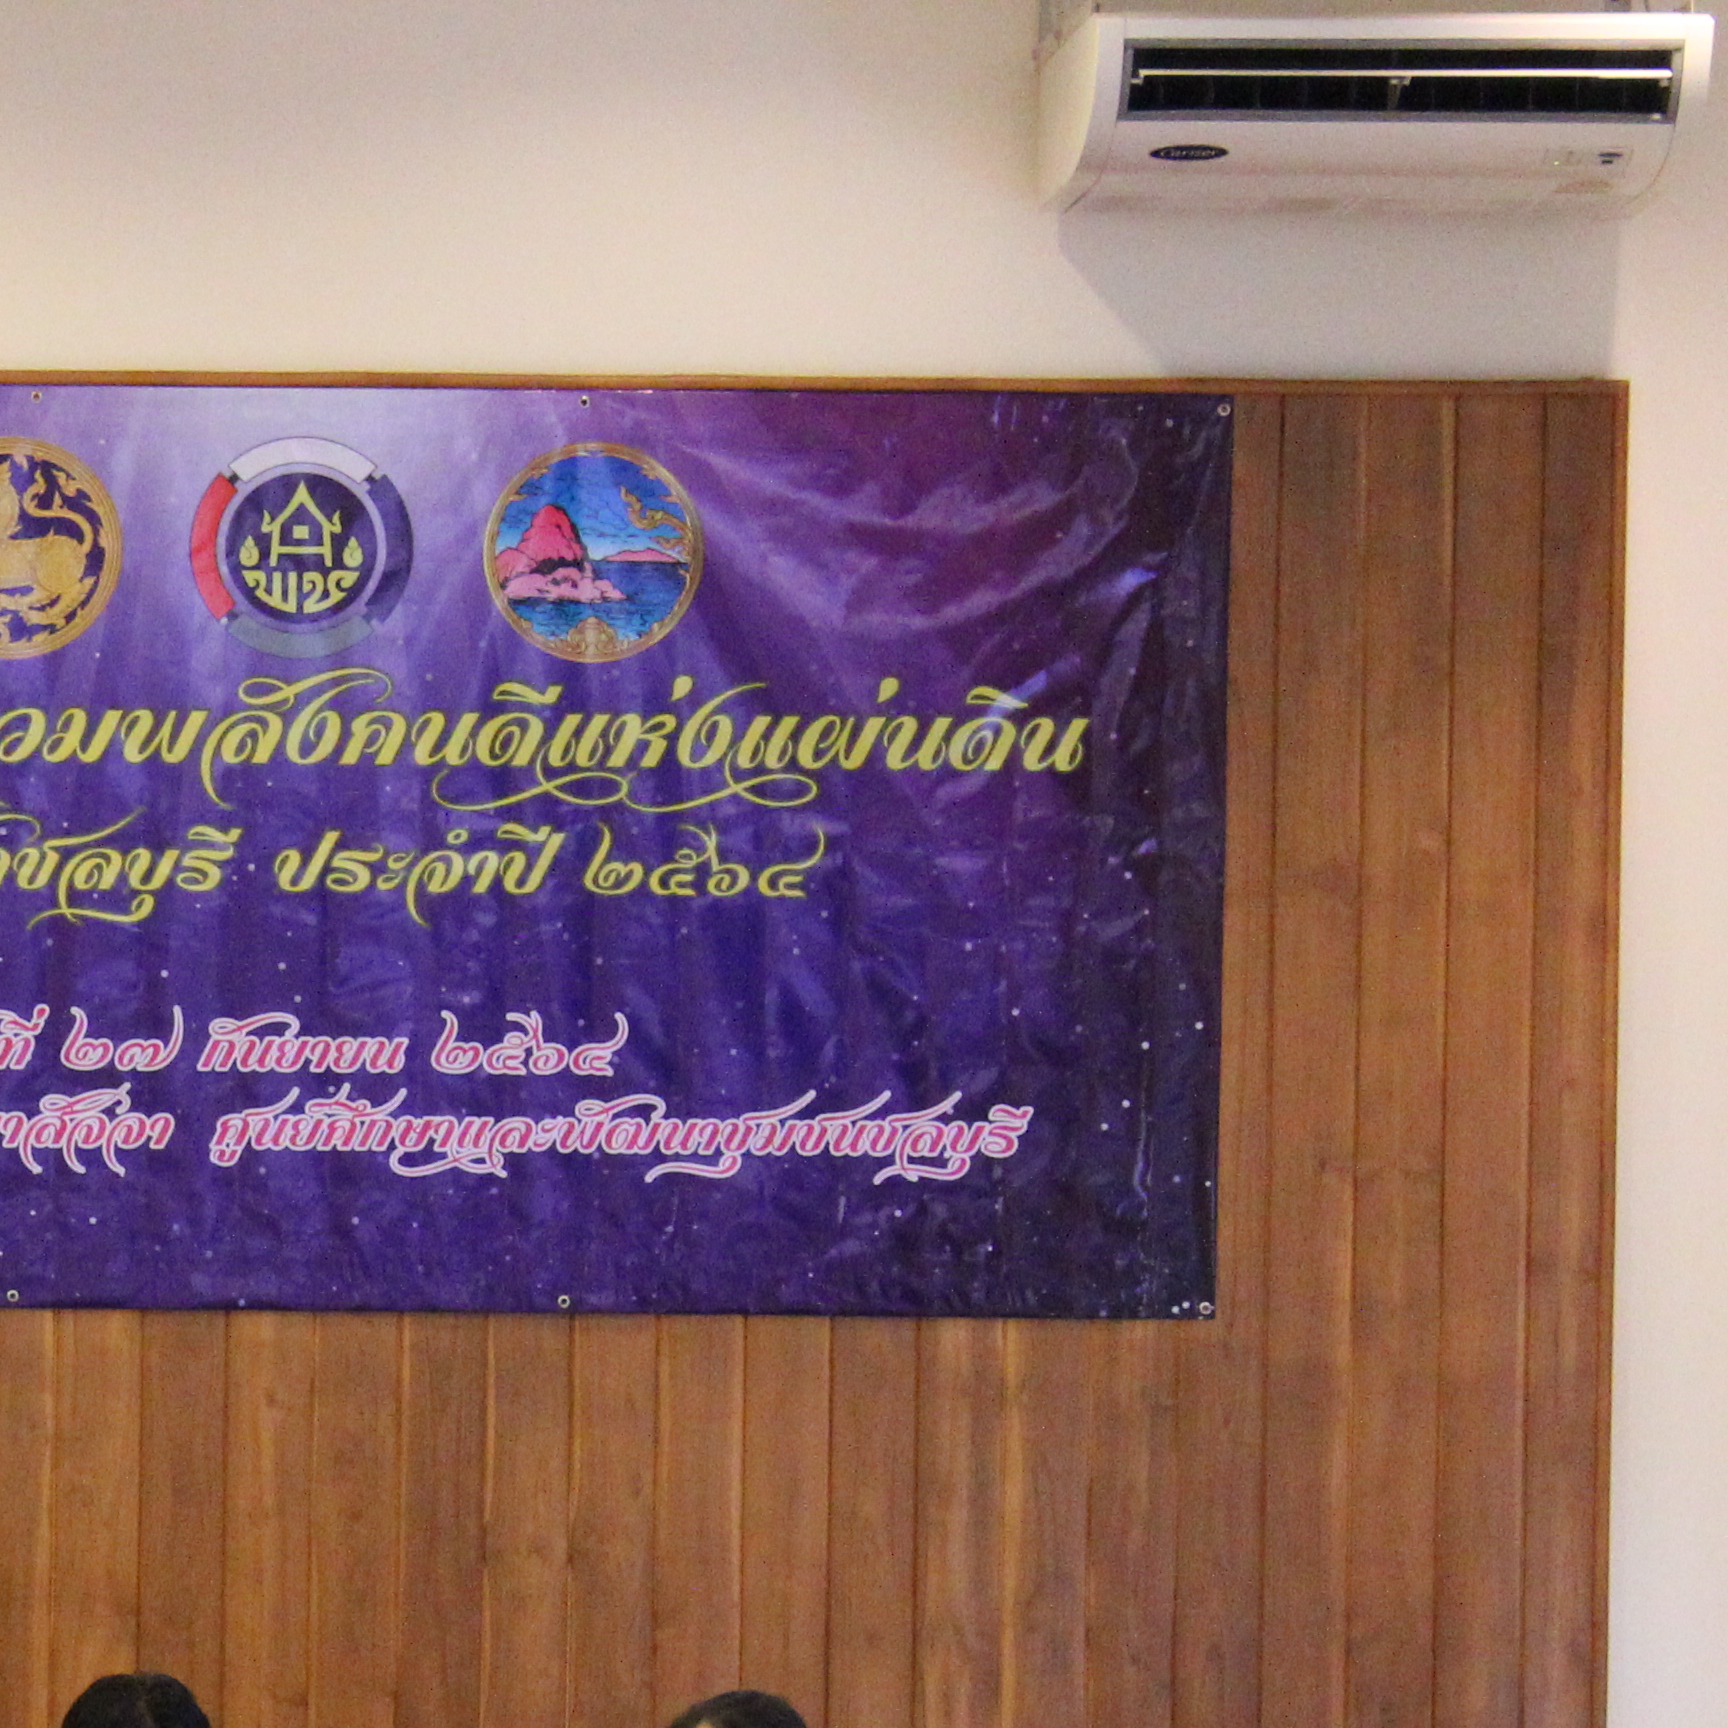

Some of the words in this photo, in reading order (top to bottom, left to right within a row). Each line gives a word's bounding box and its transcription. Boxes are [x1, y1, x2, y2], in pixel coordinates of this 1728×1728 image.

[274, 823, 565, 927] ประจำปี
[582, 821, 827, 898] ๒๕๖๔
[60, 1004, 185, 1072] ๒๗
[196, 1011, 410, 1074] กันยายน
[428, 1010, 630, 1077] ๒๕๖๔
